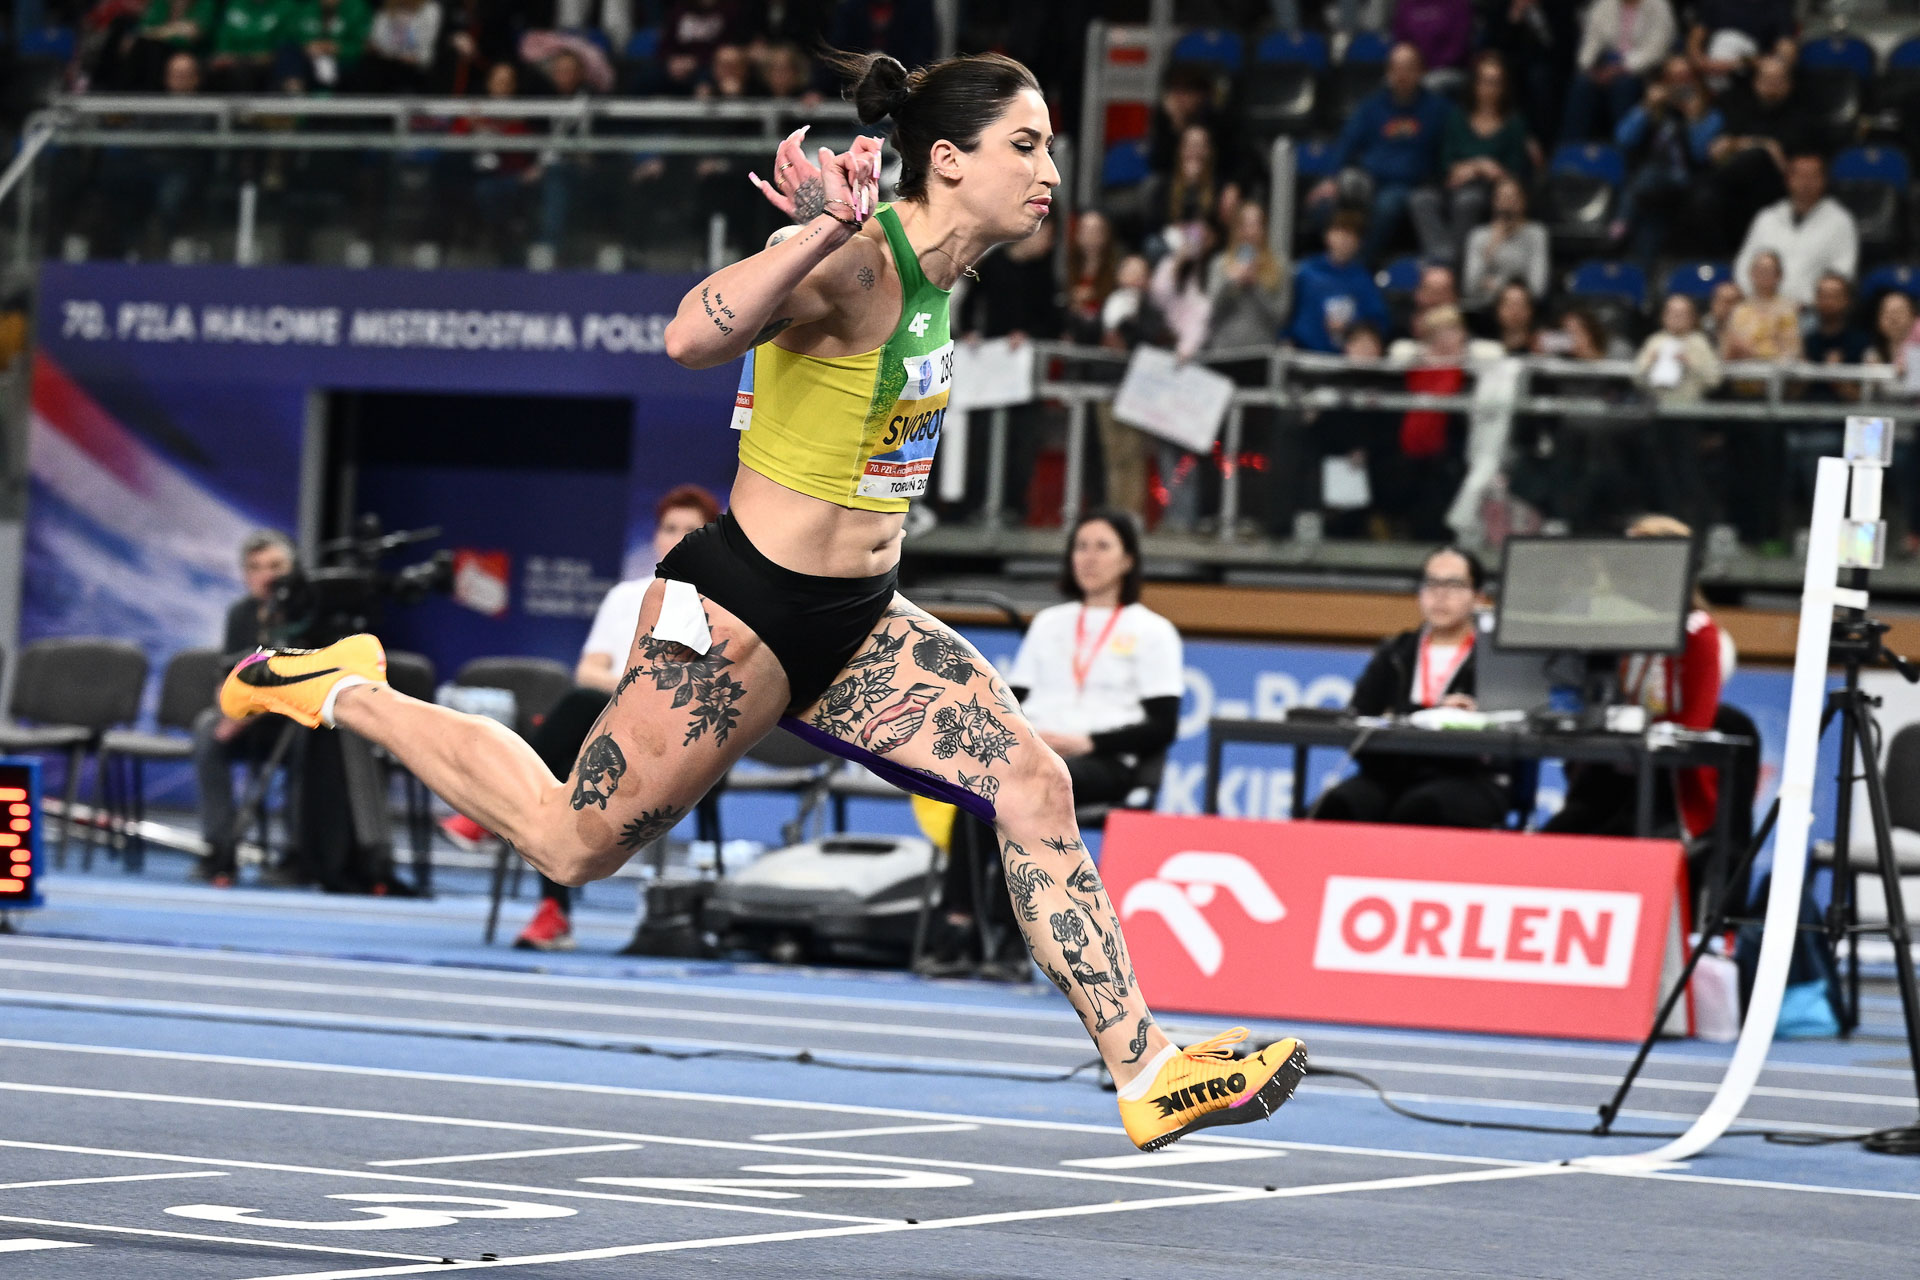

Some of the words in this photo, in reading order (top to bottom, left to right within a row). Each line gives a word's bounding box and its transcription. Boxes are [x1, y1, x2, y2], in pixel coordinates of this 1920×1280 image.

[582, 313, 671, 354] POLS
[908, 312, 932, 338] 4F
[917, 478, 926, 490] 20
[1340, 896, 1613, 967] ORLEN
[1148, 1072, 1247, 1120] NITRO
